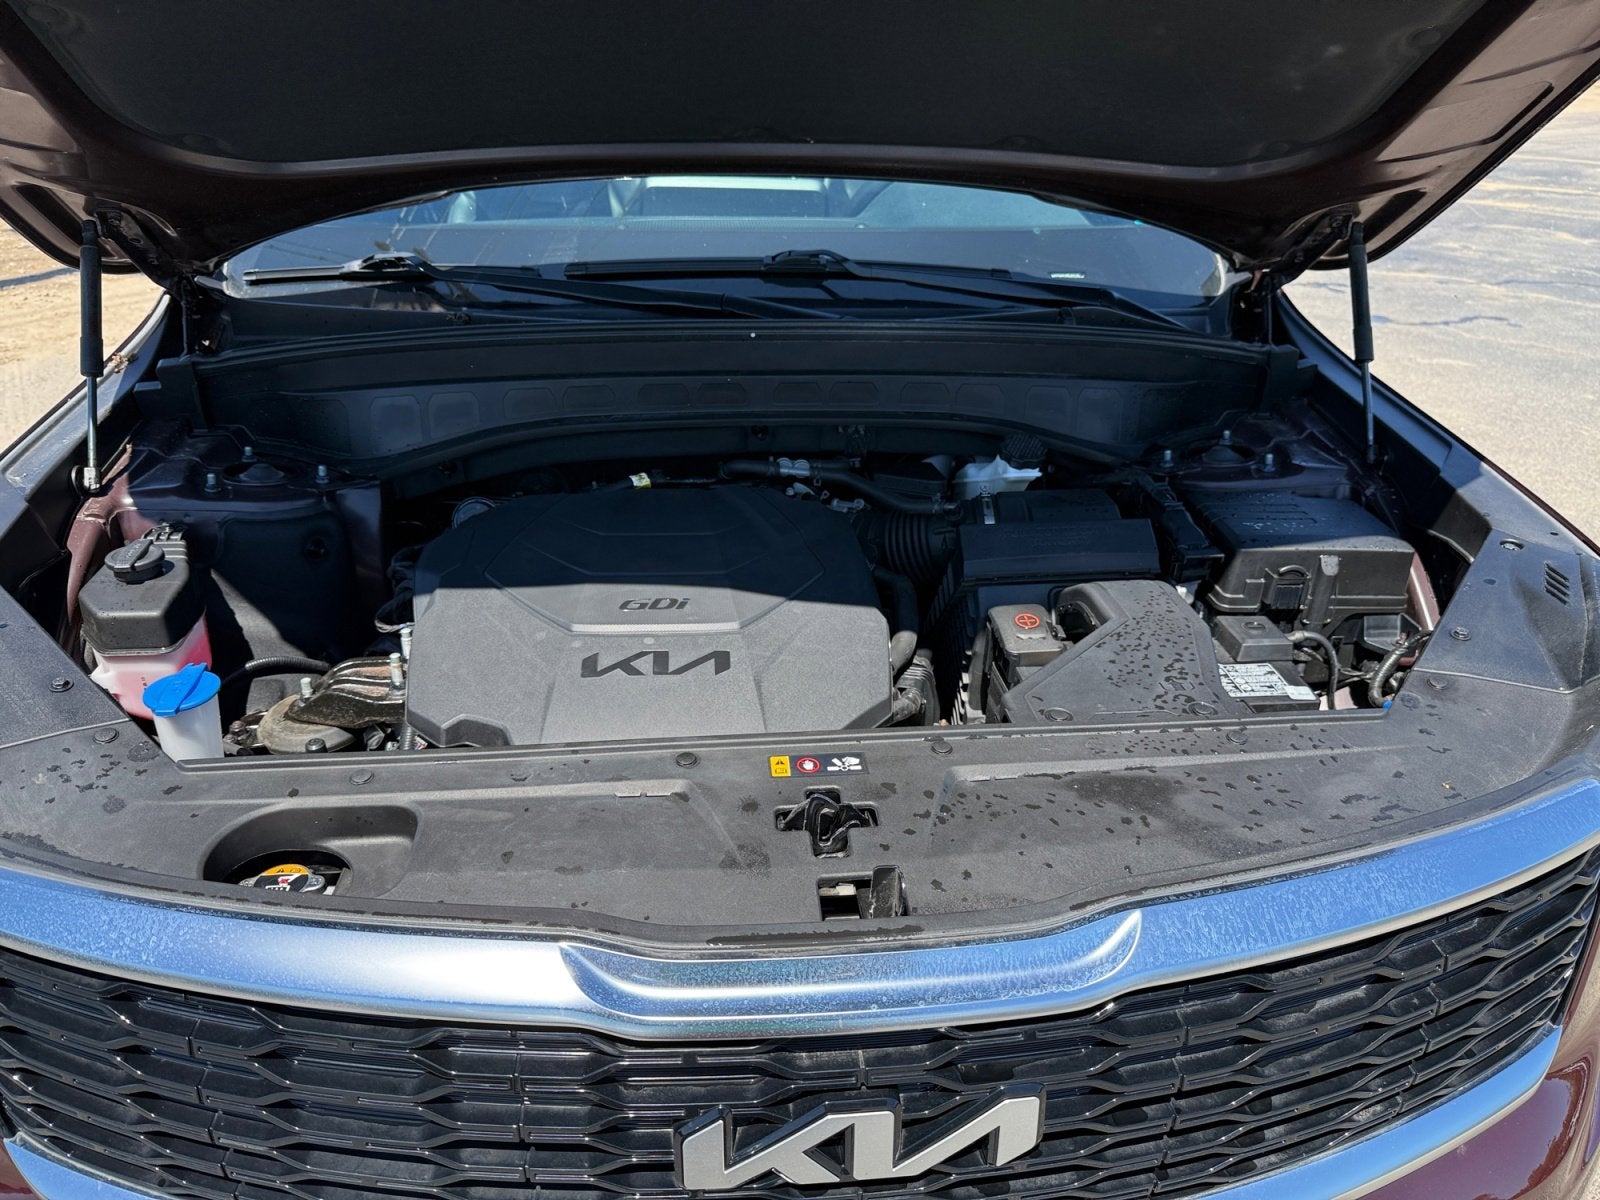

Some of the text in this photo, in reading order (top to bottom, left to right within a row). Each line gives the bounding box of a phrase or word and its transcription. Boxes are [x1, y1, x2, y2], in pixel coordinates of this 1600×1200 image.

[619, 597, 690, 611] GDi
[581, 650, 731, 678] KIA
[677, 1086, 1044, 1190] KIA
